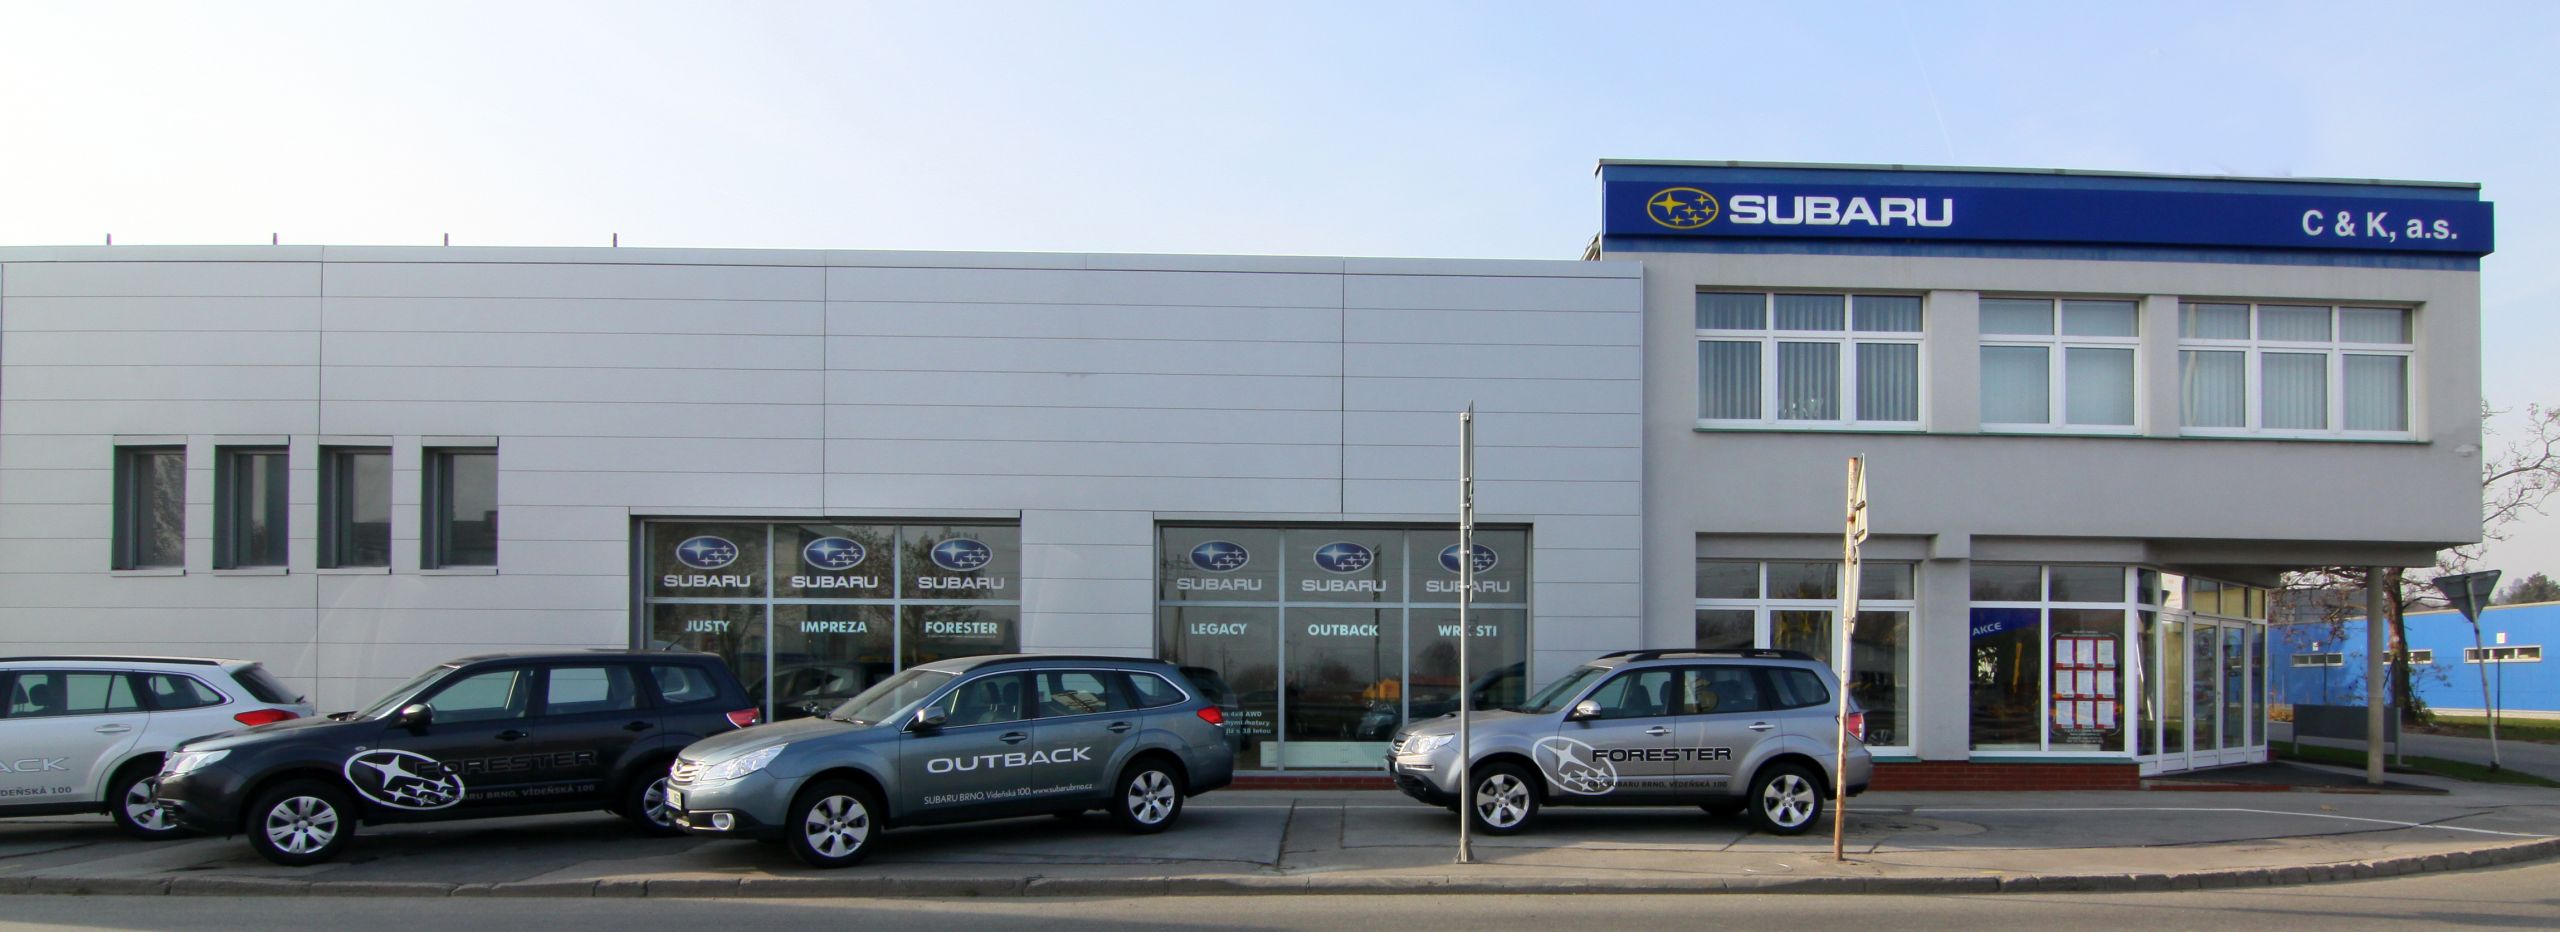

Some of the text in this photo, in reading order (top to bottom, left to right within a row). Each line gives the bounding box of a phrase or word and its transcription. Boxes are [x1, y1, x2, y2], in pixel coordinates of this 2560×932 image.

[1729, 194, 1953, 227] SUBARU
[2302, 209, 2458, 243] C & K, a.s.
[664, 574, 751, 588] SUBARU
[791, 575, 879, 589] SUBARU
[918, 576, 1005, 590] SUBARU
[1176, 578, 1262, 592] SUBARU
[1302, 579, 1387, 593] SUBARU
[685, 620, 731, 634] JUSTY
[801, 621, 868, 633] IMPREZA
[925, 621, 998, 635] FORESTER
[1191, 623, 1248, 636] LEGACY
[1307, 624, 1380, 637] OUTBACK
[1438, 625, 1497, 637] WR STI
[1972, 622, 2002, 636] AKCE
[927, 746, 1091, 773] OUTBACK
[1591, 747, 1732, 762] FORESTER
[415, 750, 596, 777] FORESTER
[51, 786, 73, 795] 100
[924, 793, 958, 805] SUBARU
[959, 791, 985, 802] BRNO,
